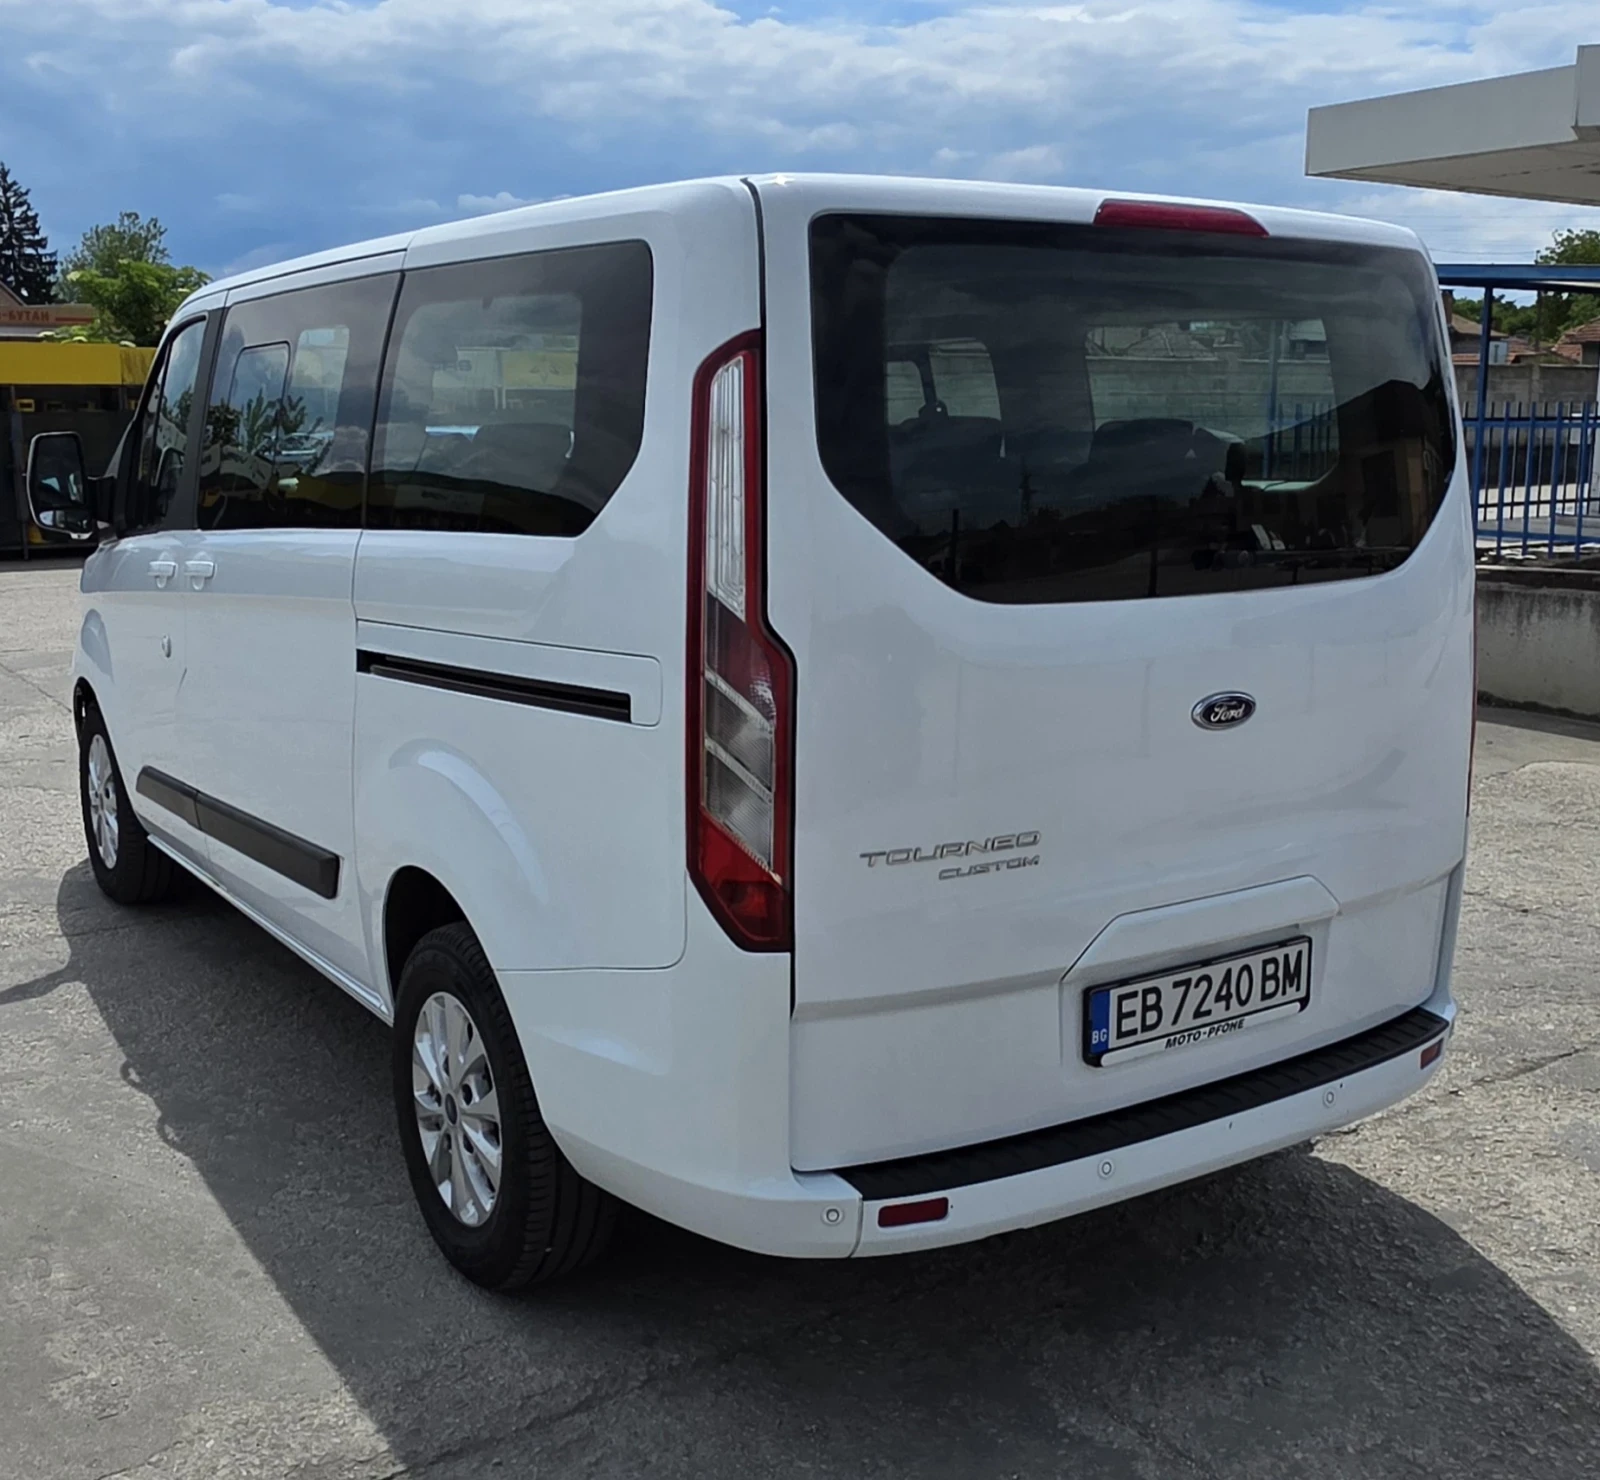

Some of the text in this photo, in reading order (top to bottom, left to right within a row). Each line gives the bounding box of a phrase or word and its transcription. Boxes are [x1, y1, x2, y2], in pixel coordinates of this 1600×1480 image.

[1210, 702, 1245, 721] Ford
[860, 831, 1041, 867] TOURNEO
[939, 855, 1040, 880] CUSTOM
[1116, 951, 1303, 1040] EB 7240 BM
[1092, 1029, 1108, 1044] BG
